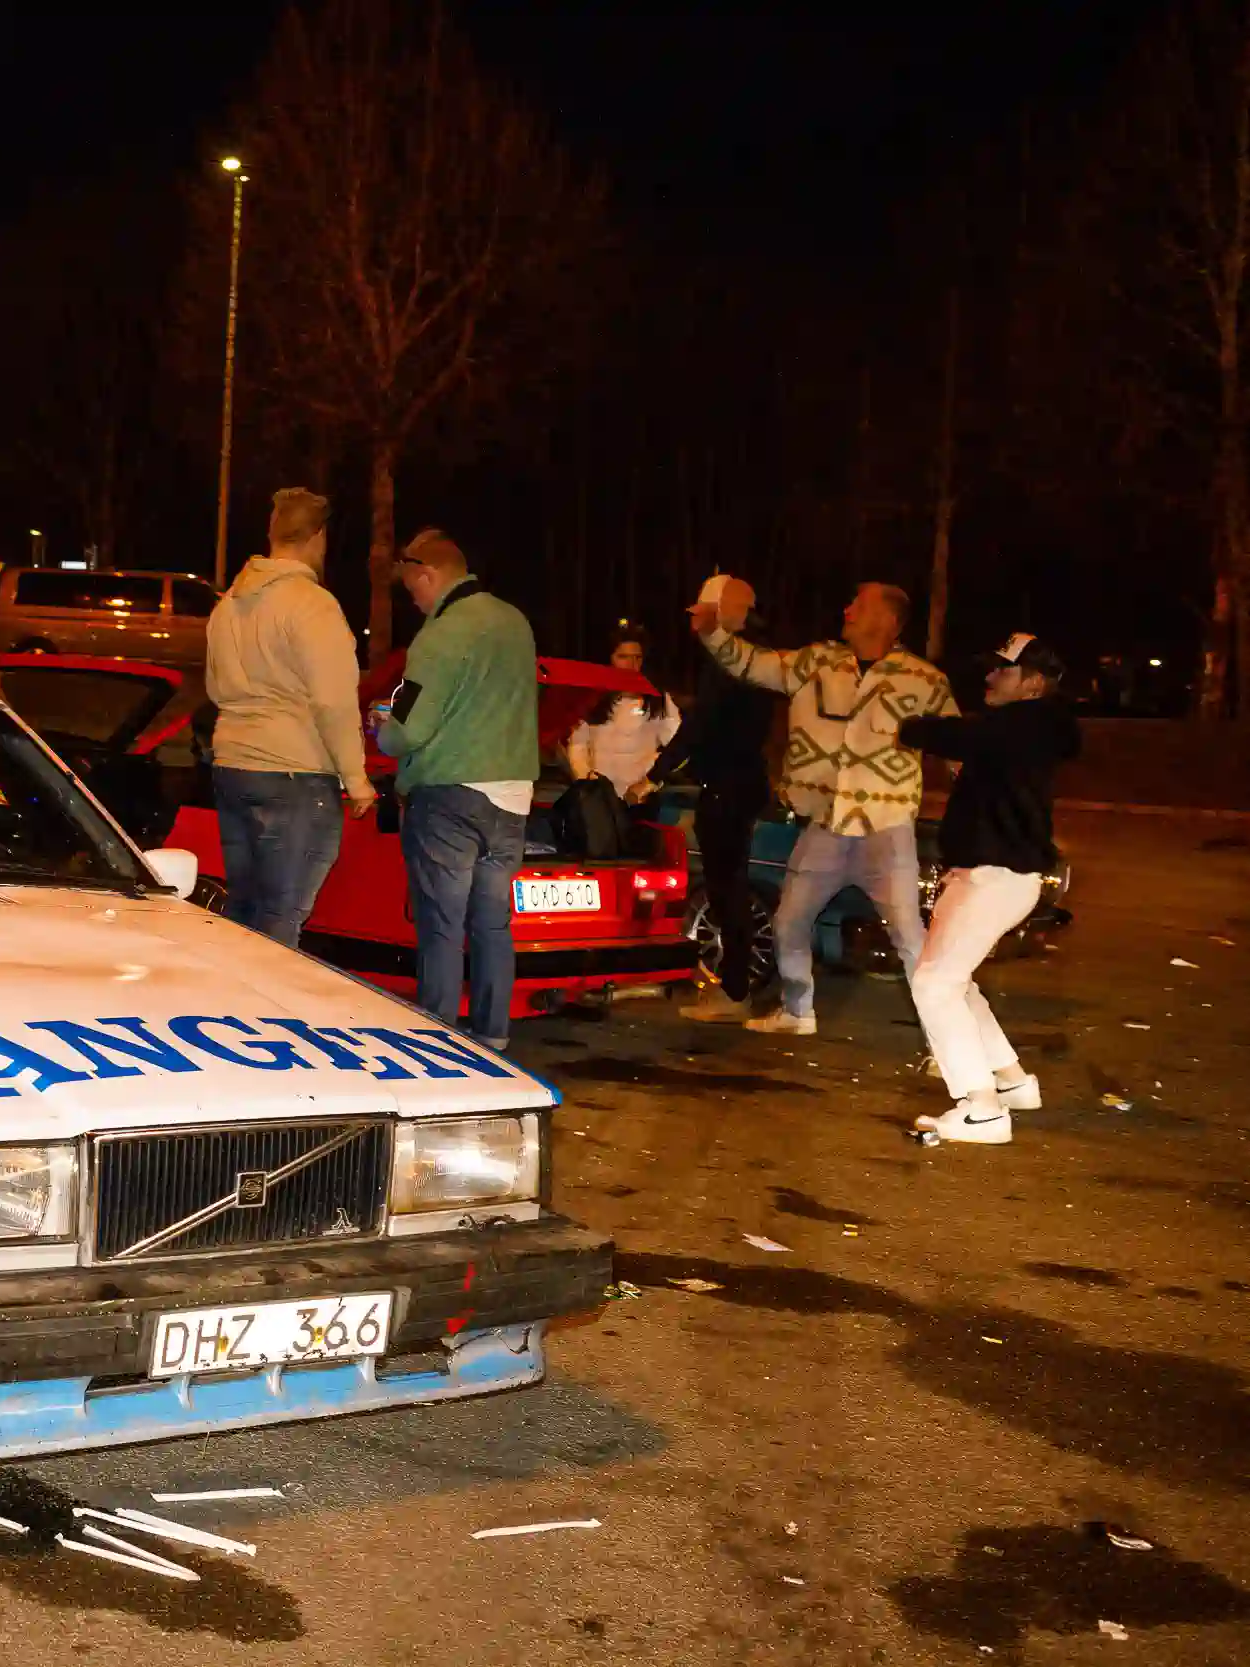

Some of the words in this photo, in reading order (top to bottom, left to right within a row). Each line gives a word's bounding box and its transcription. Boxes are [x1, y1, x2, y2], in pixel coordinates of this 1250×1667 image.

[566, 883, 594, 906] 610
[161, 1313, 255, 1368] DHZ
[292, 1302, 379, 1352] 366
